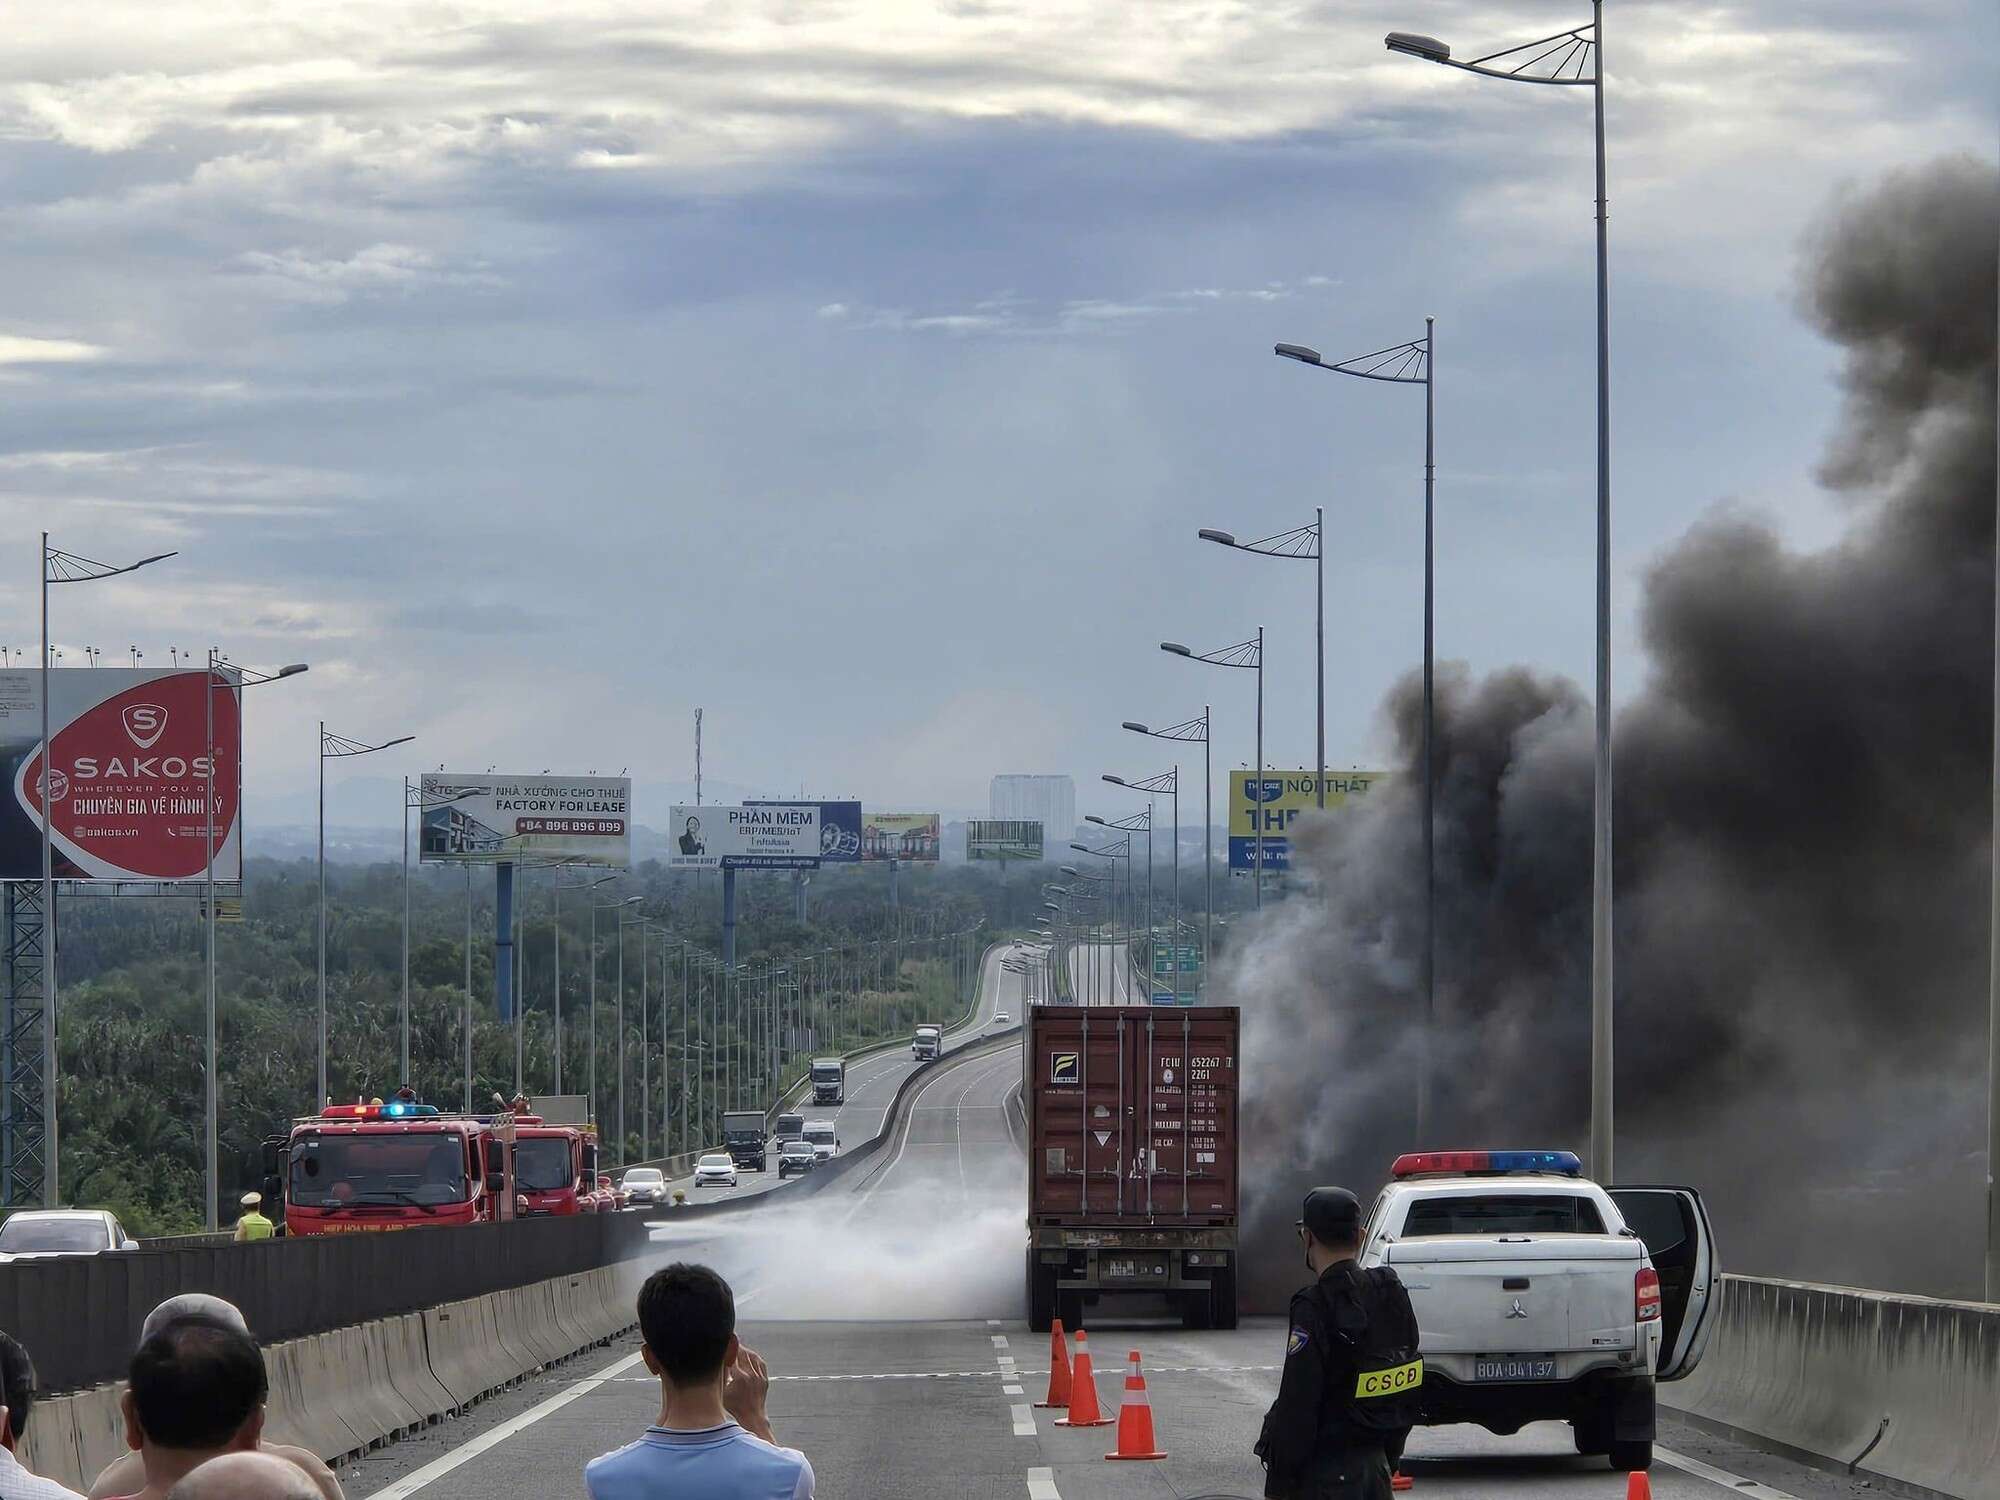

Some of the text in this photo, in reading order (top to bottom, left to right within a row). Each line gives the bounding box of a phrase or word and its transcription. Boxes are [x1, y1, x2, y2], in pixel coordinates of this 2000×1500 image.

[73, 757, 216, 778] SAKOS
[571, 788, 595, 798] CHO
[73, 796, 123, 815] CHUYÊN
[127, 799, 147, 815] GIA
[170, 795, 204, 815] HÀNH
[496, 800, 626, 813] FACTORY FOR LEASE
[1161, 1057, 1180, 1068] FCIU
[1191, 1057, 1220, 1068] 652267
[1191, 1069, 1210, 1080] 22G1
[1365, 1367, 1417, 1393] CSCĐ
